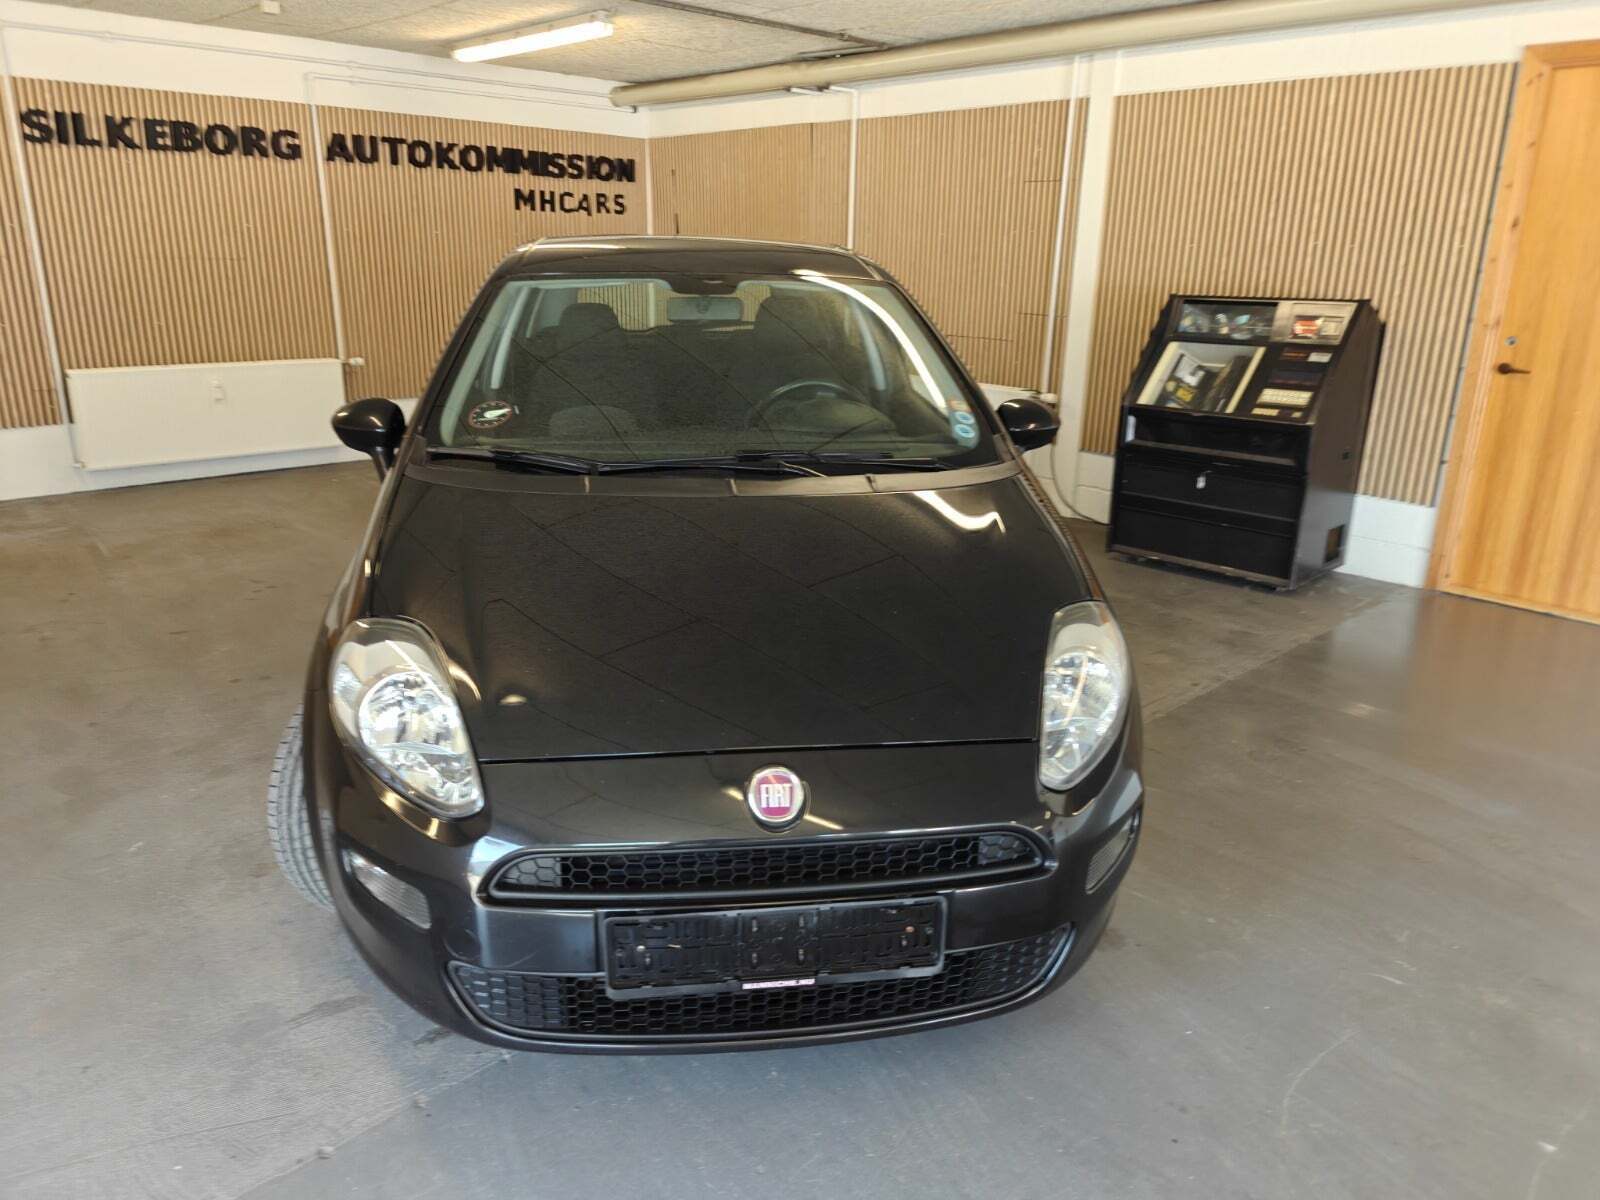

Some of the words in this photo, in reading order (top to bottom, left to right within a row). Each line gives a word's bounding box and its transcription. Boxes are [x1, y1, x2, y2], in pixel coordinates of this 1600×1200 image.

[20, 108, 302, 160] SILKEBORG
[327, 132, 635, 182] AUTOKOMMISSION
[760, 783, 791, 808] FIAT
